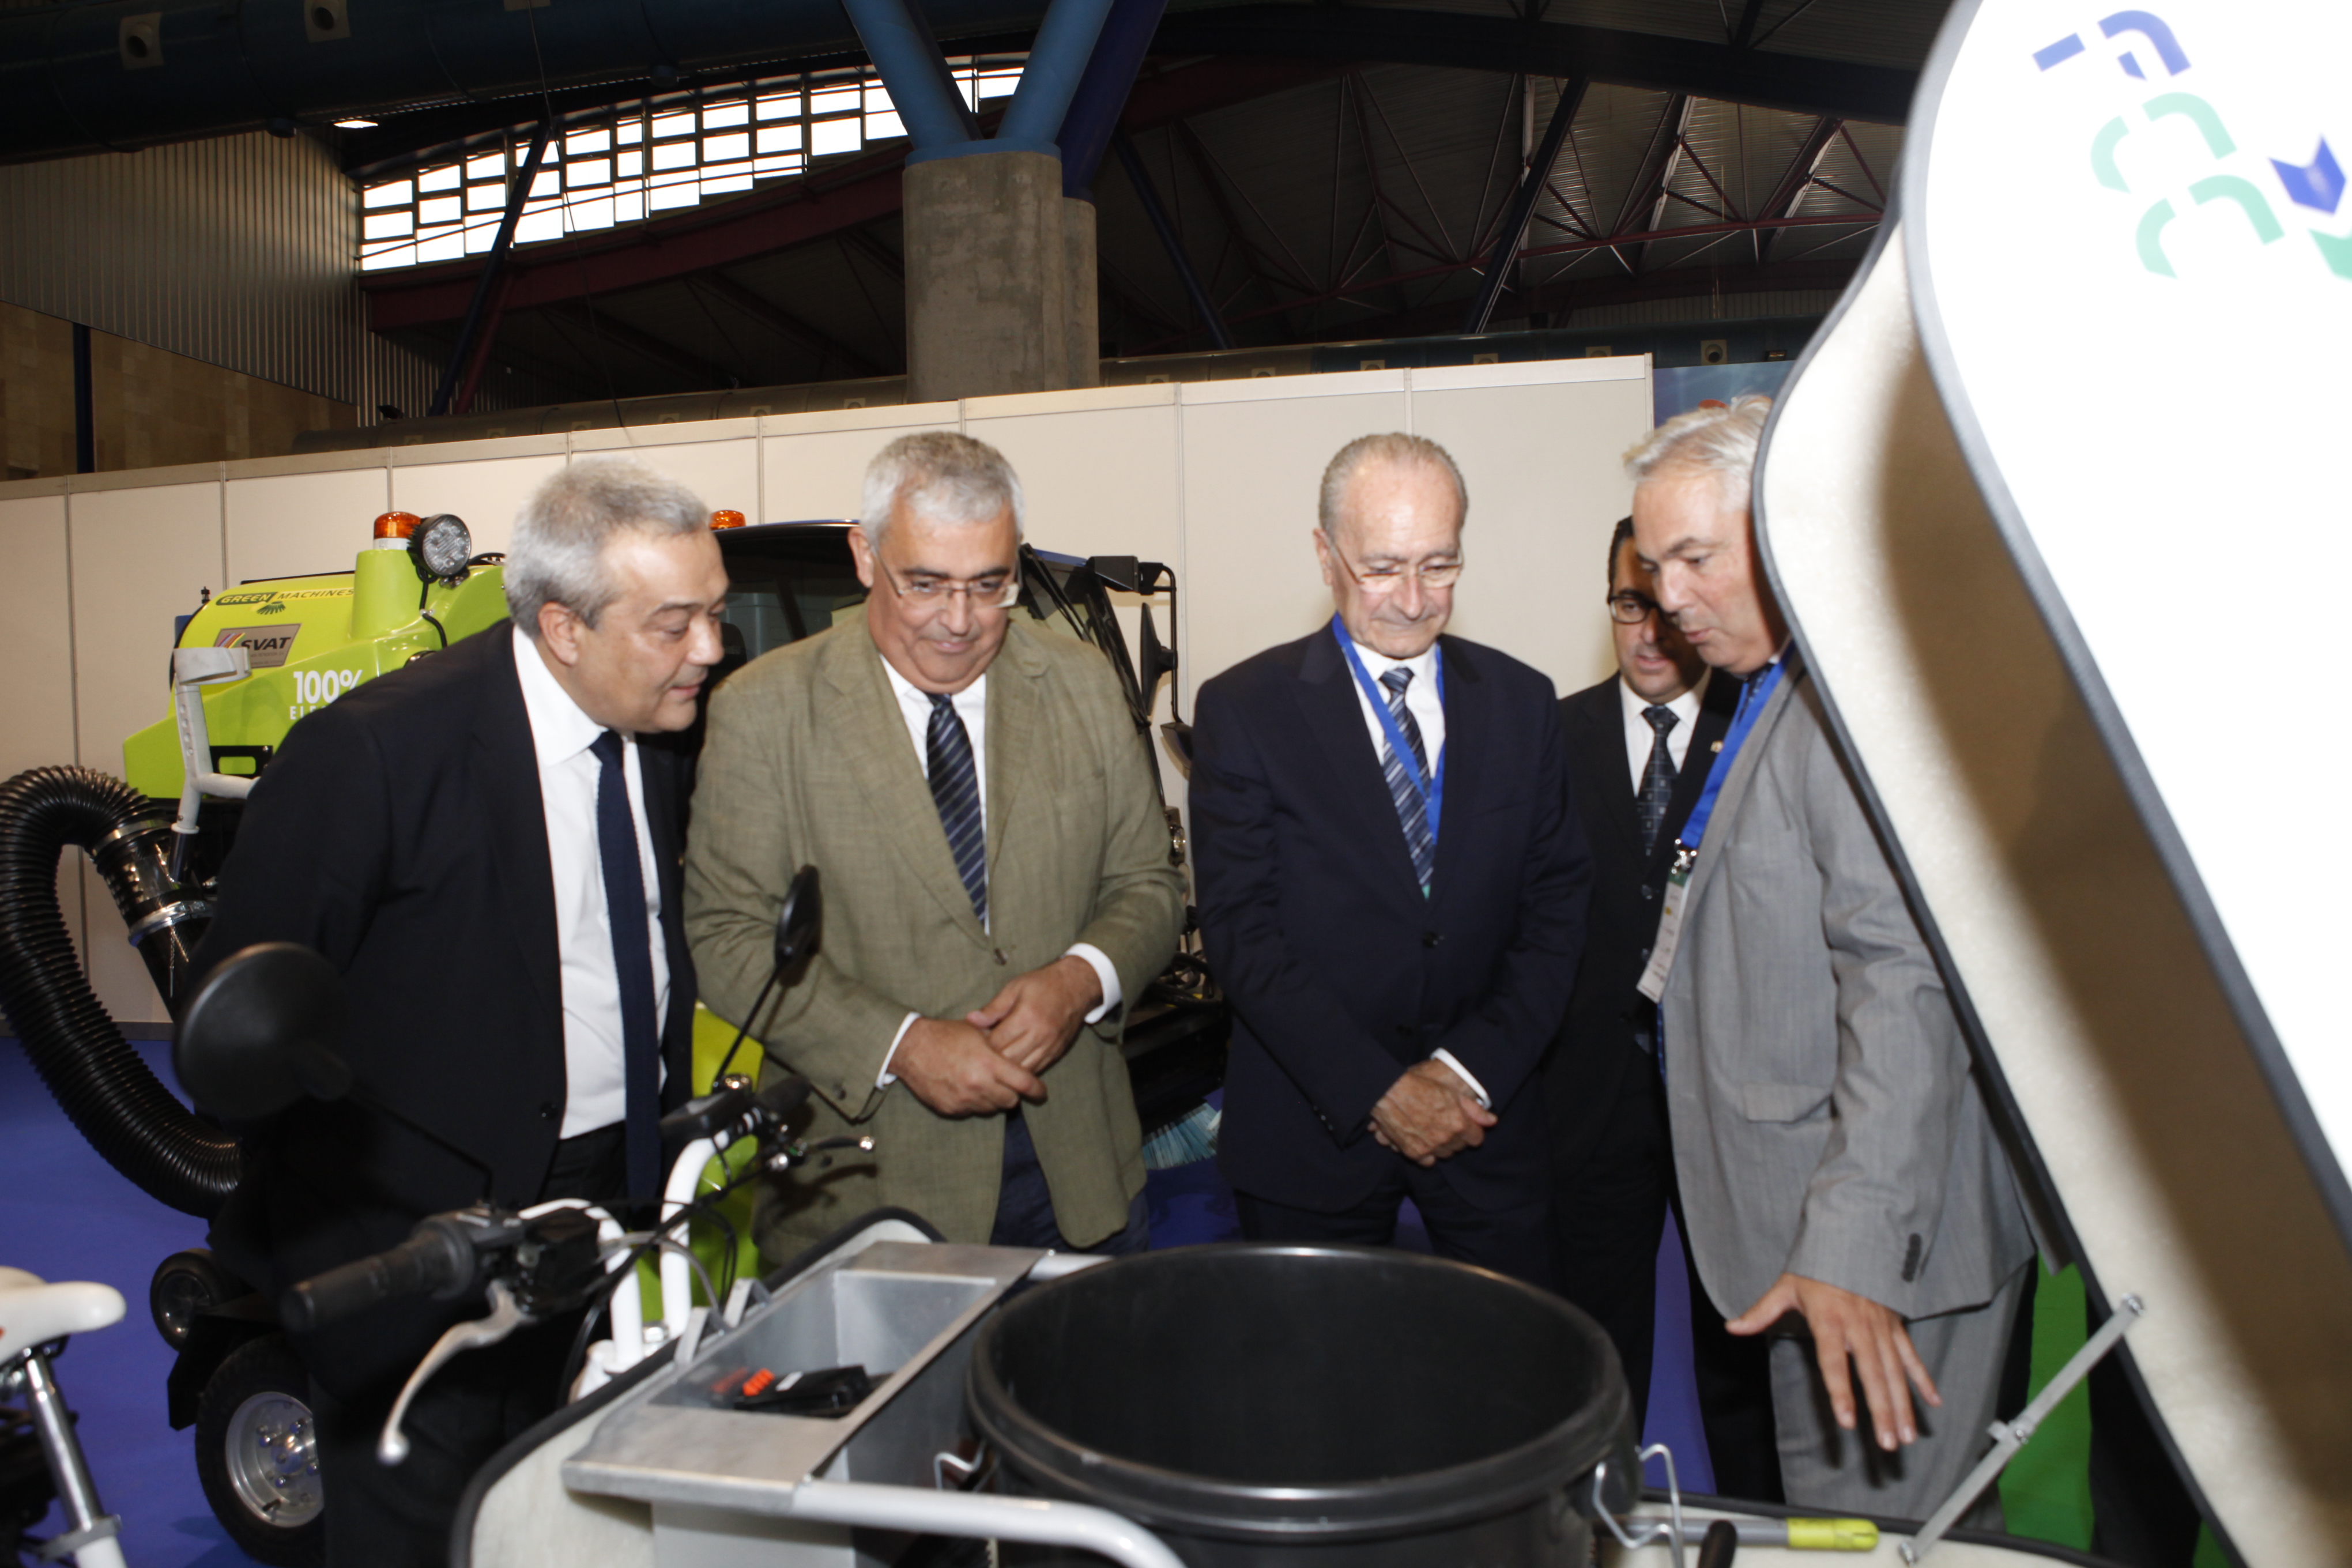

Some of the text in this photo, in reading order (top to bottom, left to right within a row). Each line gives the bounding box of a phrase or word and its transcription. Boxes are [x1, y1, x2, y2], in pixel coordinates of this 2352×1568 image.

[220, 589, 354, 604] GREEN MACHINES
[241, 637, 291, 651] SVAT
[293, 669, 363, 704] 100%
